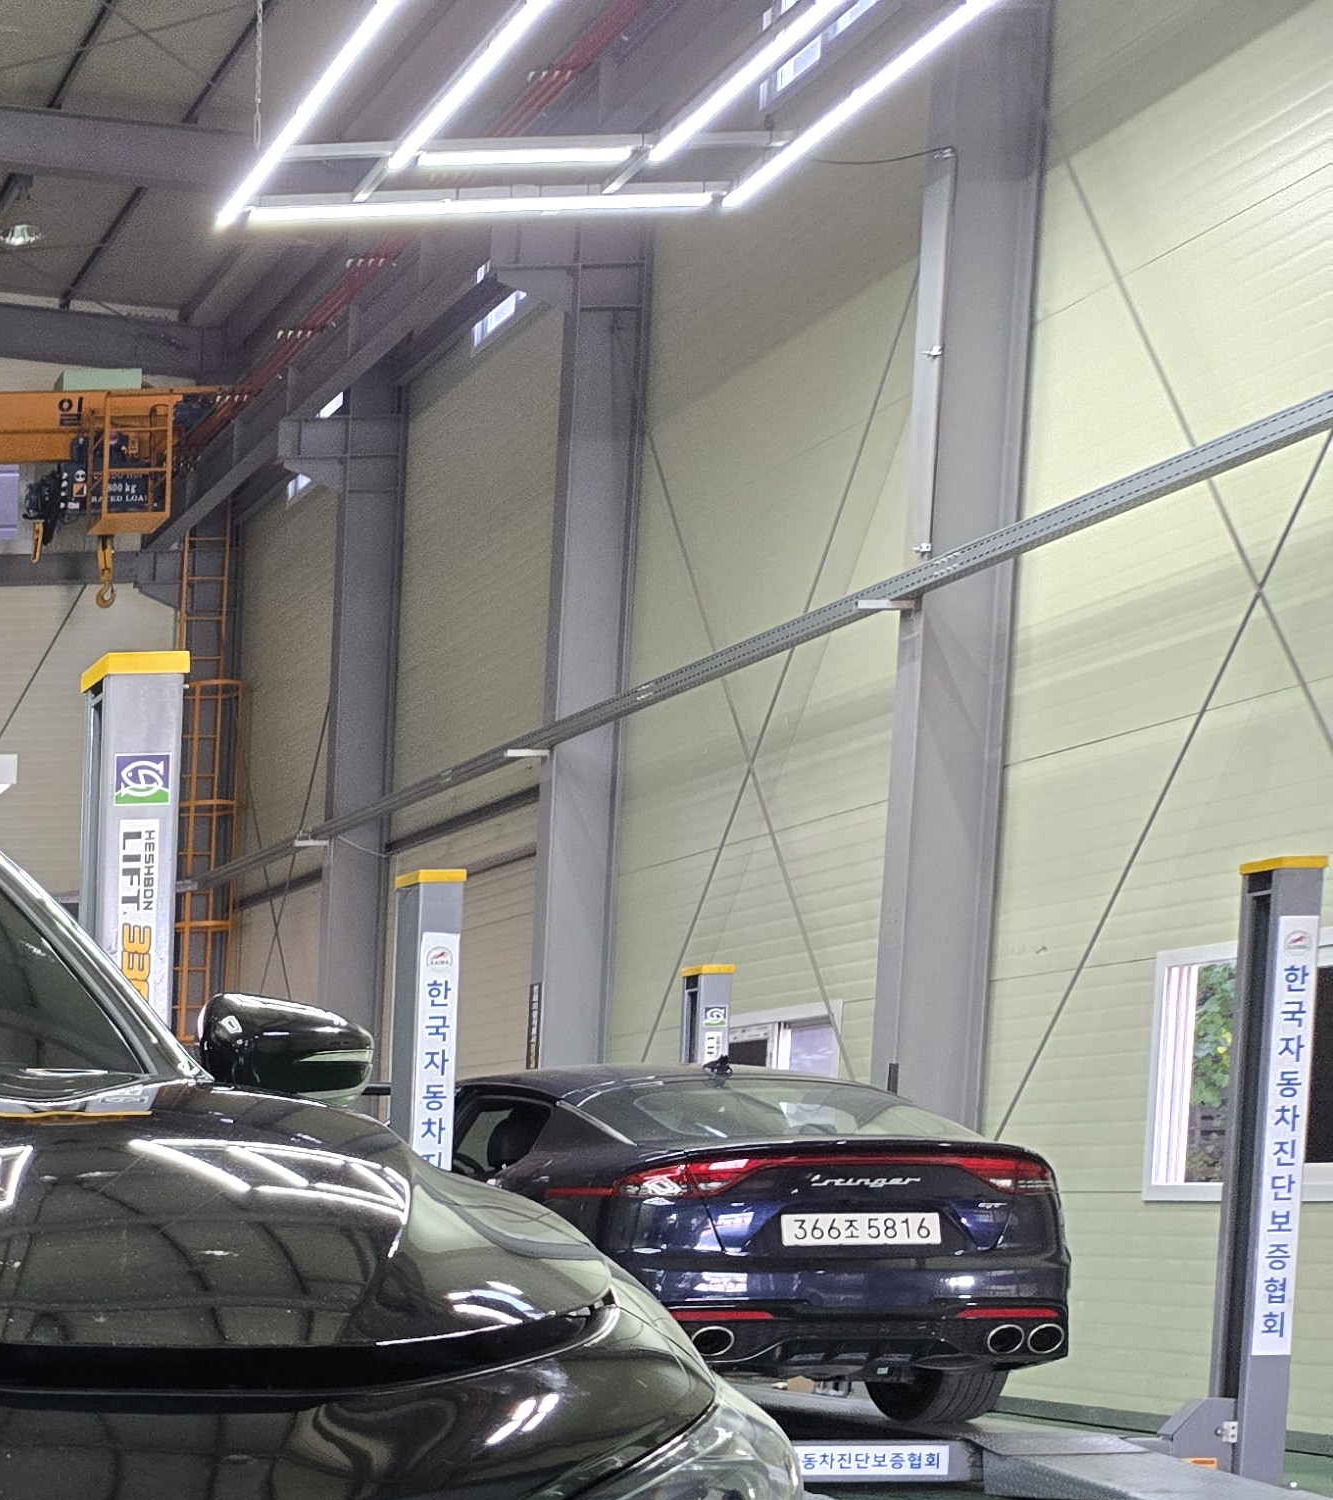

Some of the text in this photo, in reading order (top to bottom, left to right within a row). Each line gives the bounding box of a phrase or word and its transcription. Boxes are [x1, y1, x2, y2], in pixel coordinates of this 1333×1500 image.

[125, 494, 148, 502] LOA
[121, 830, 142, 912] LIFT
[143, 829, 156, 912] HESHBON
[1260, 964, 1310, 1339] 한국자동차진단보증협회
[797, 1452, 940, 1470] 동차진단보증협회
